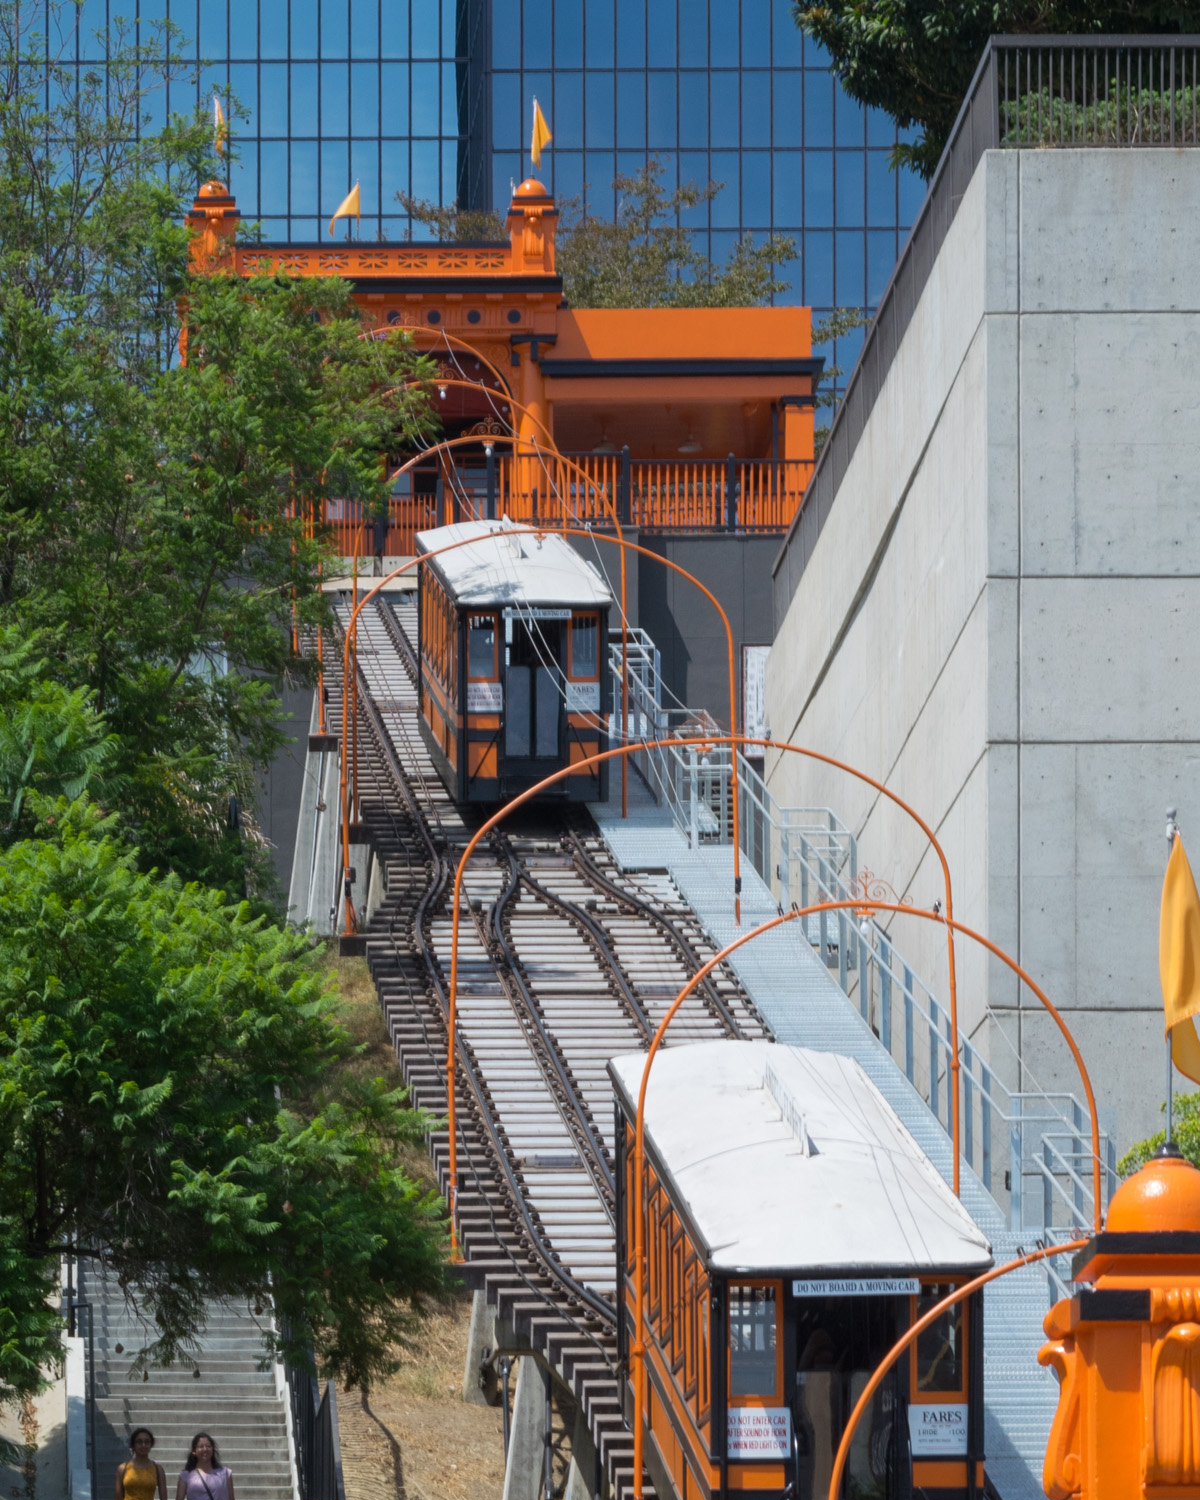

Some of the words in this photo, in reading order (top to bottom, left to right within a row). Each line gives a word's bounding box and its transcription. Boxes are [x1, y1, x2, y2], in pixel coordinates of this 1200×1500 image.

[797, 1283, 808, 1293] DO
[811, 1283, 827, 1293] NOT
[829, 1282, 857, 1292] BOARD
[859, 1282, 864, 1291] A
[866, 1281, 897, 1291] MOVING
[898, 1281, 915, 1291] CAR
[738, 1416, 751, 1425] NOT
[752, 1416, 772, 1425] ENTER
[773, 1416, 786, 1425] CAR
[923, 1411, 962, 1422] FARES
[744, 1428, 763, 1437] SOUND
[771, 1428, 786, 1437] HORN
[733, 1440, 748, 1449] WHEN
[749, 1440, 759, 1449] RED
[759, 1440, 772, 1449] LIGHT
[779, 1440, 787, 1449] ON
